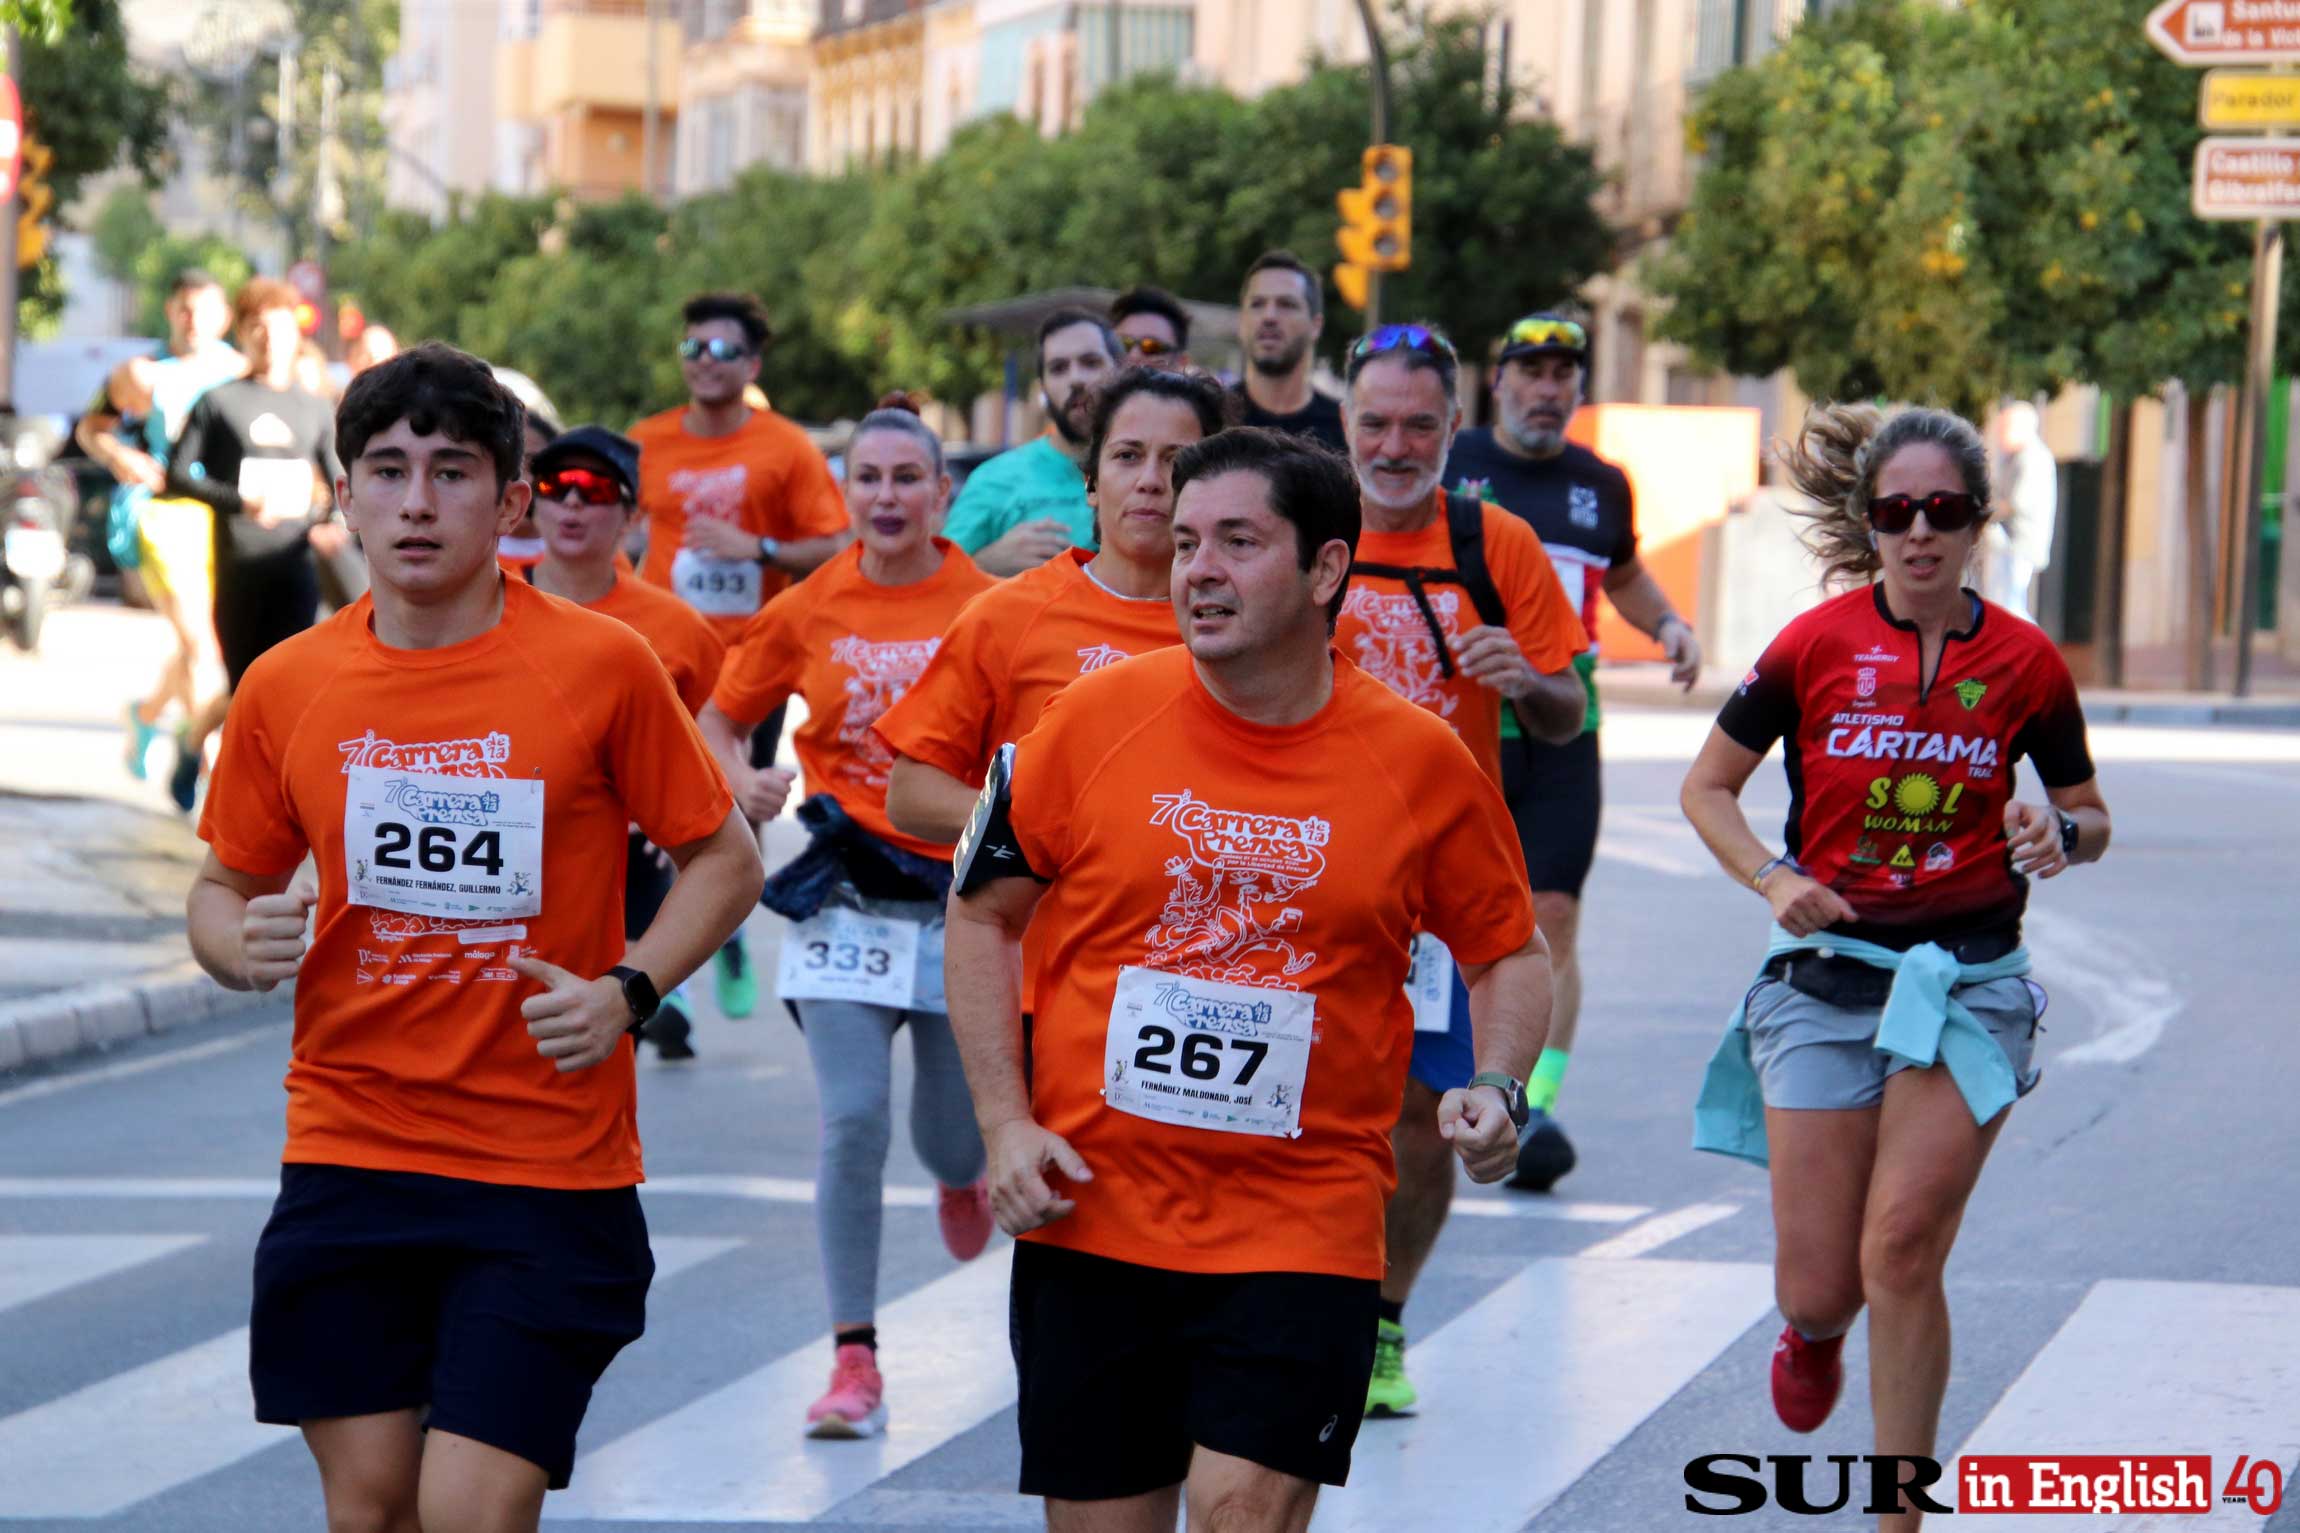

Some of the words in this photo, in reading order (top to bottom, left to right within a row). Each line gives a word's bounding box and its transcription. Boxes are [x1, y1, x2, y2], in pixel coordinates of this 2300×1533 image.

[2232, 0, 2300, 21] Santu
[2210, 151, 2294, 176] Castillo
[2209, 179, 2300, 201] Gibralfa
[688, 571, 745, 594] 493
[1832, 712, 1904, 726] ATLETISMO
[371, 741, 485, 768] Carrera
[402, 784, 482, 810] Carrera
[417, 807, 487, 826] Prensa
[1180, 808, 1302, 841] Carrera
[1864, 815, 1952, 833] WOMAN
[374, 821, 504, 876] 264
[1201, 831, 1308, 860] Prensa
[376, 876, 413, 888] FERNÁNDEZ
[459, 884, 501, 895] GUILLERMO
[804, 940, 890, 976] 333
[1171, 990, 1253, 1020] Carrera
[1186, 1014, 1258, 1037] Prensa
[1133, 1024, 1269, 1086] 267
[1141, 1080, 1182, 1095] FERNÁNDEZ
[1182, 1087, 1232, 1105] MALDONADO,
[1233, 1093, 1253, 1106] JOSÉ
